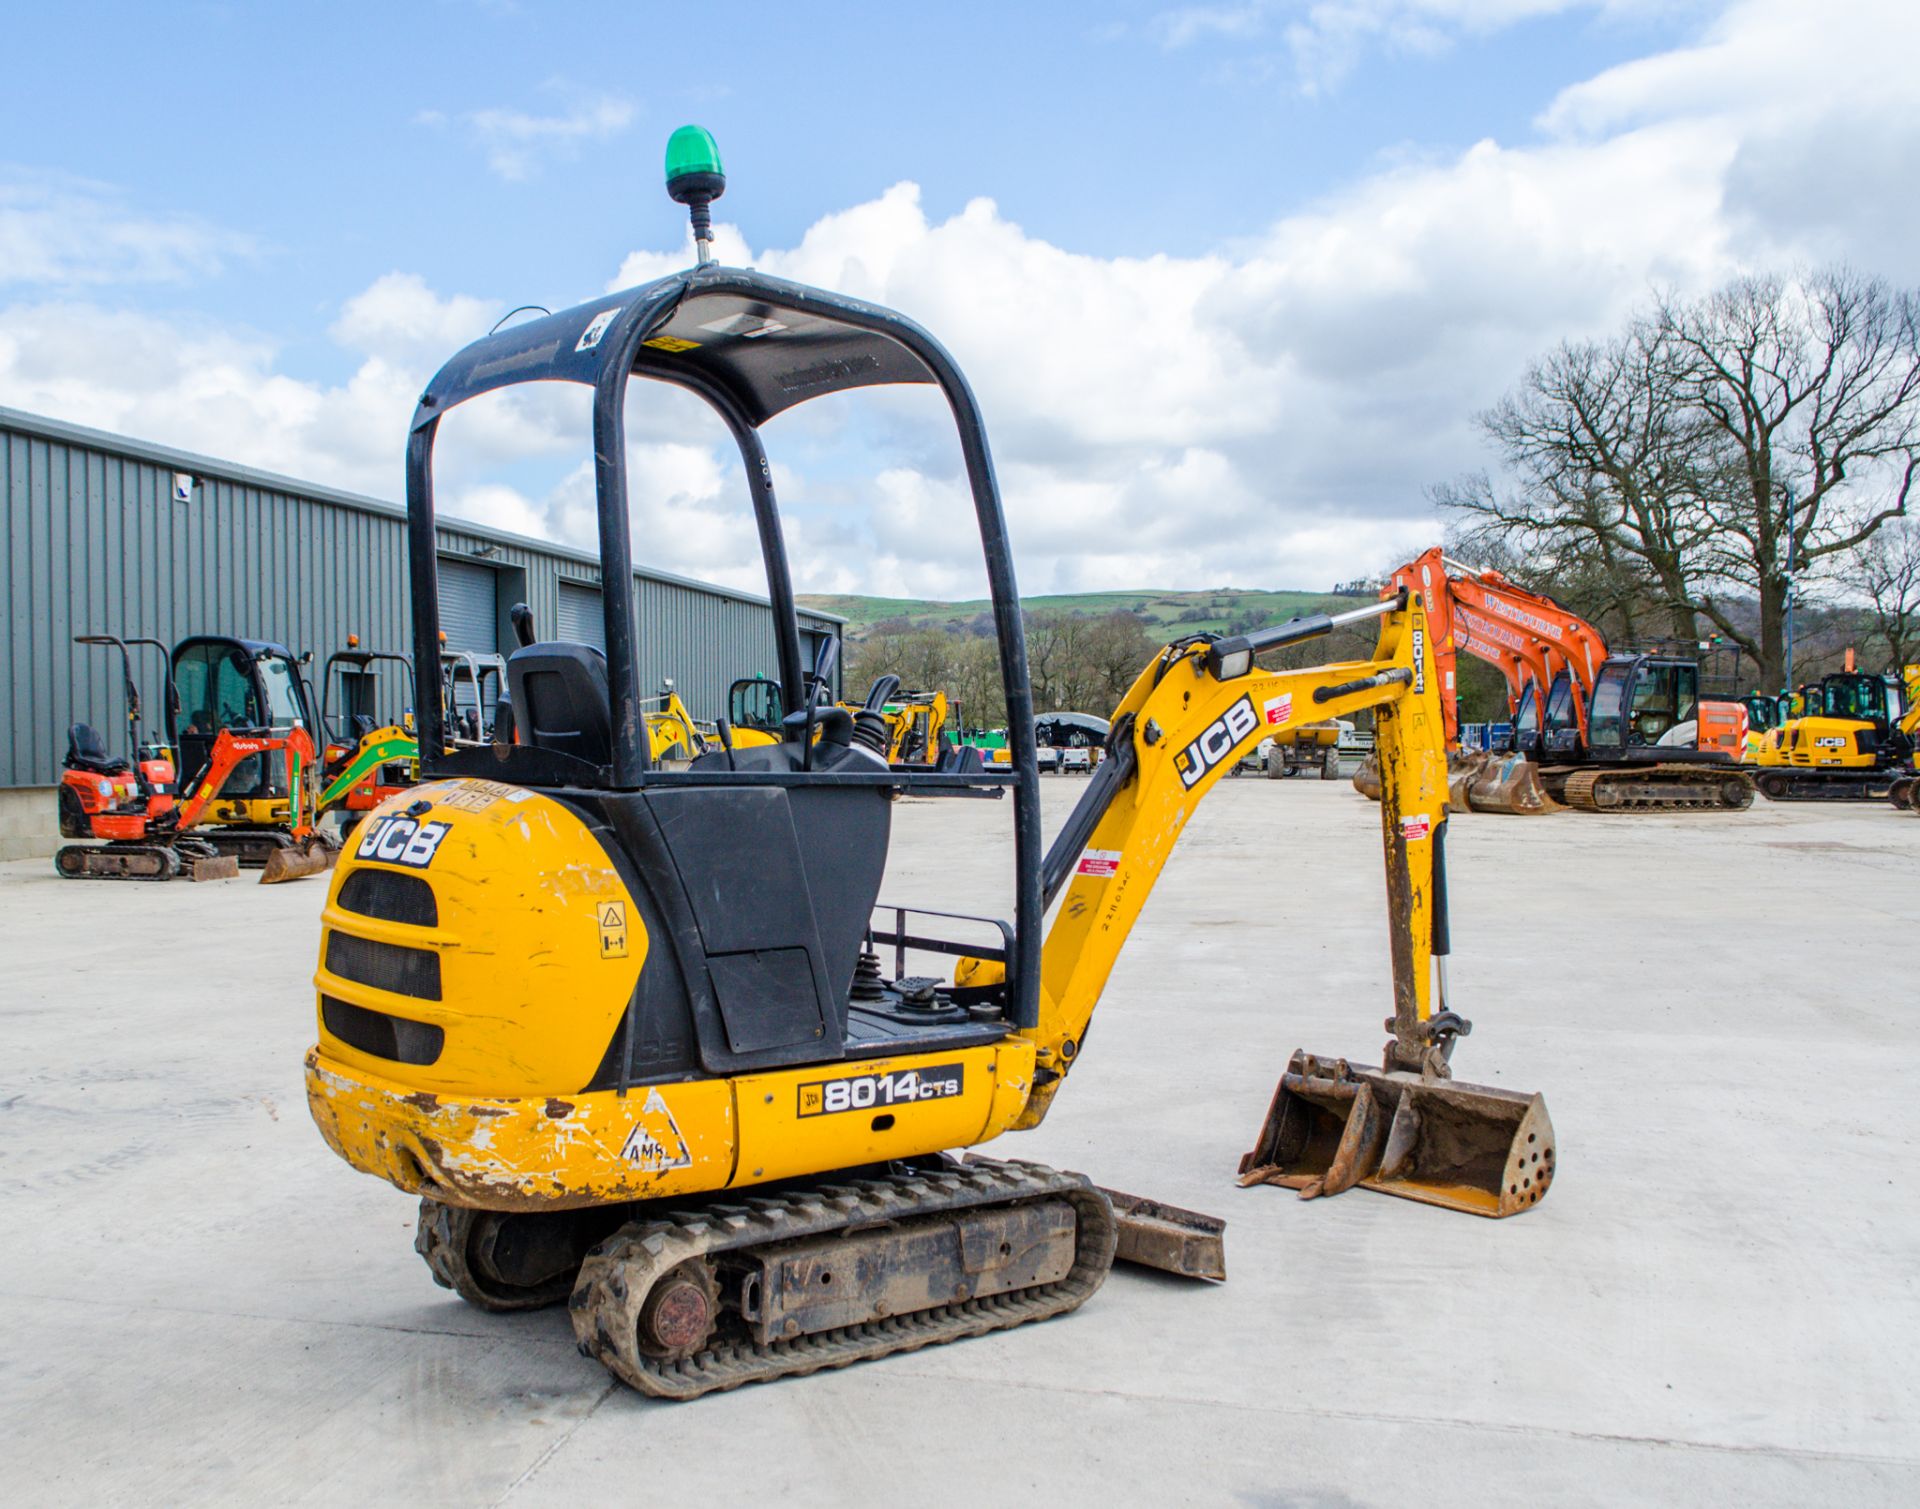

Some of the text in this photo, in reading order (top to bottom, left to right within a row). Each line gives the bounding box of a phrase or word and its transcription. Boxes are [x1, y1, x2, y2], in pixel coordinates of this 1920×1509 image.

[1182, 699, 1257, 785] JCB
[1815, 737, 1846, 747] JCB
[358, 819, 446, 865] JCB
